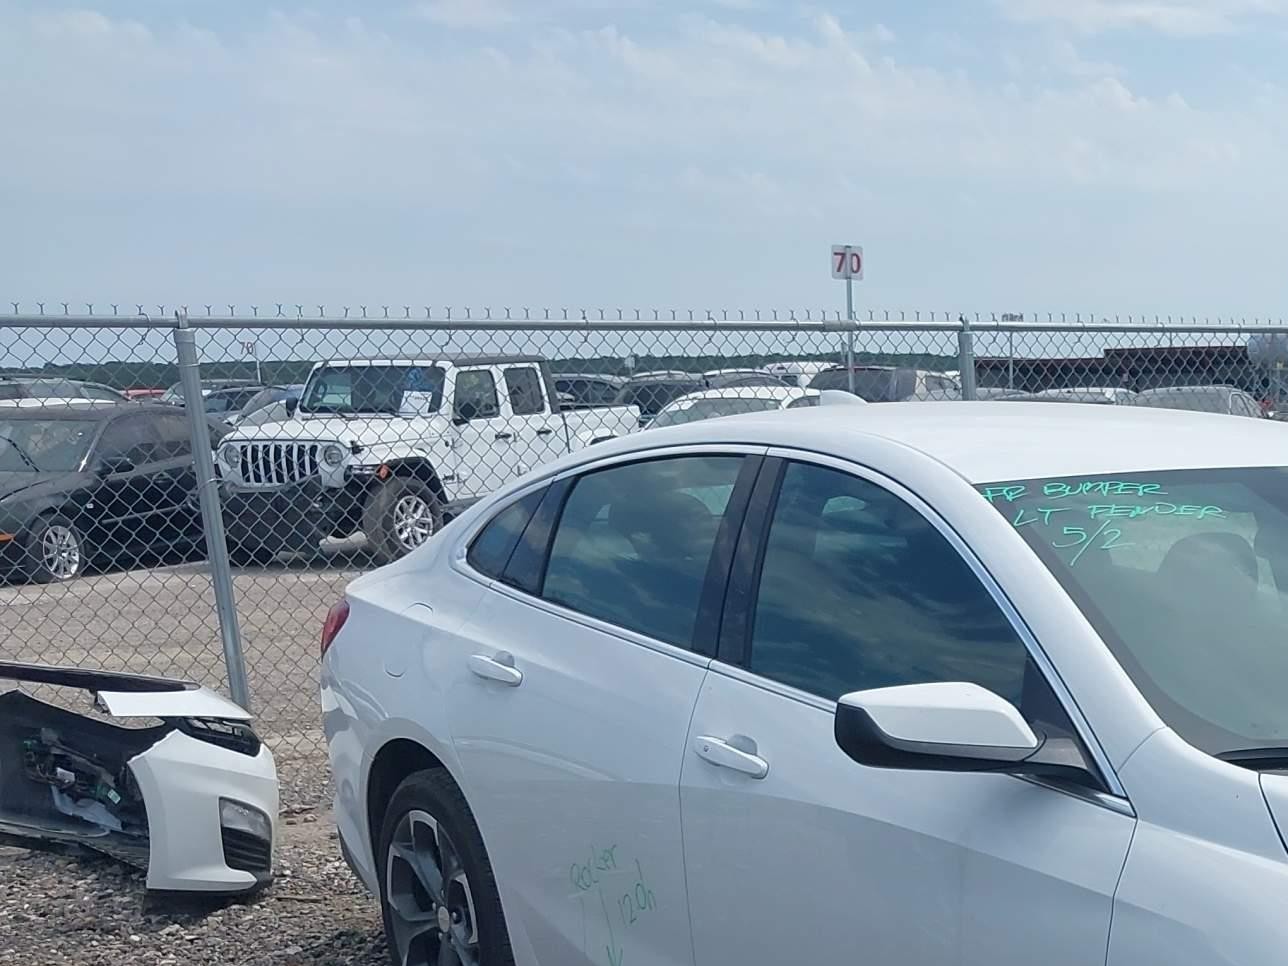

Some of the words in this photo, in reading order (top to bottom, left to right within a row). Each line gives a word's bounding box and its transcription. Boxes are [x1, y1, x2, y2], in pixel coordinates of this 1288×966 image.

[833, 252, 861, 274] 70
[1043, 481, 1168, 499] BUMPER
[1013, 507, 1073, 527] LT
[1087, 502, 1226, 520] FENDER
[1052, 519, 1136, 567] 5/2
